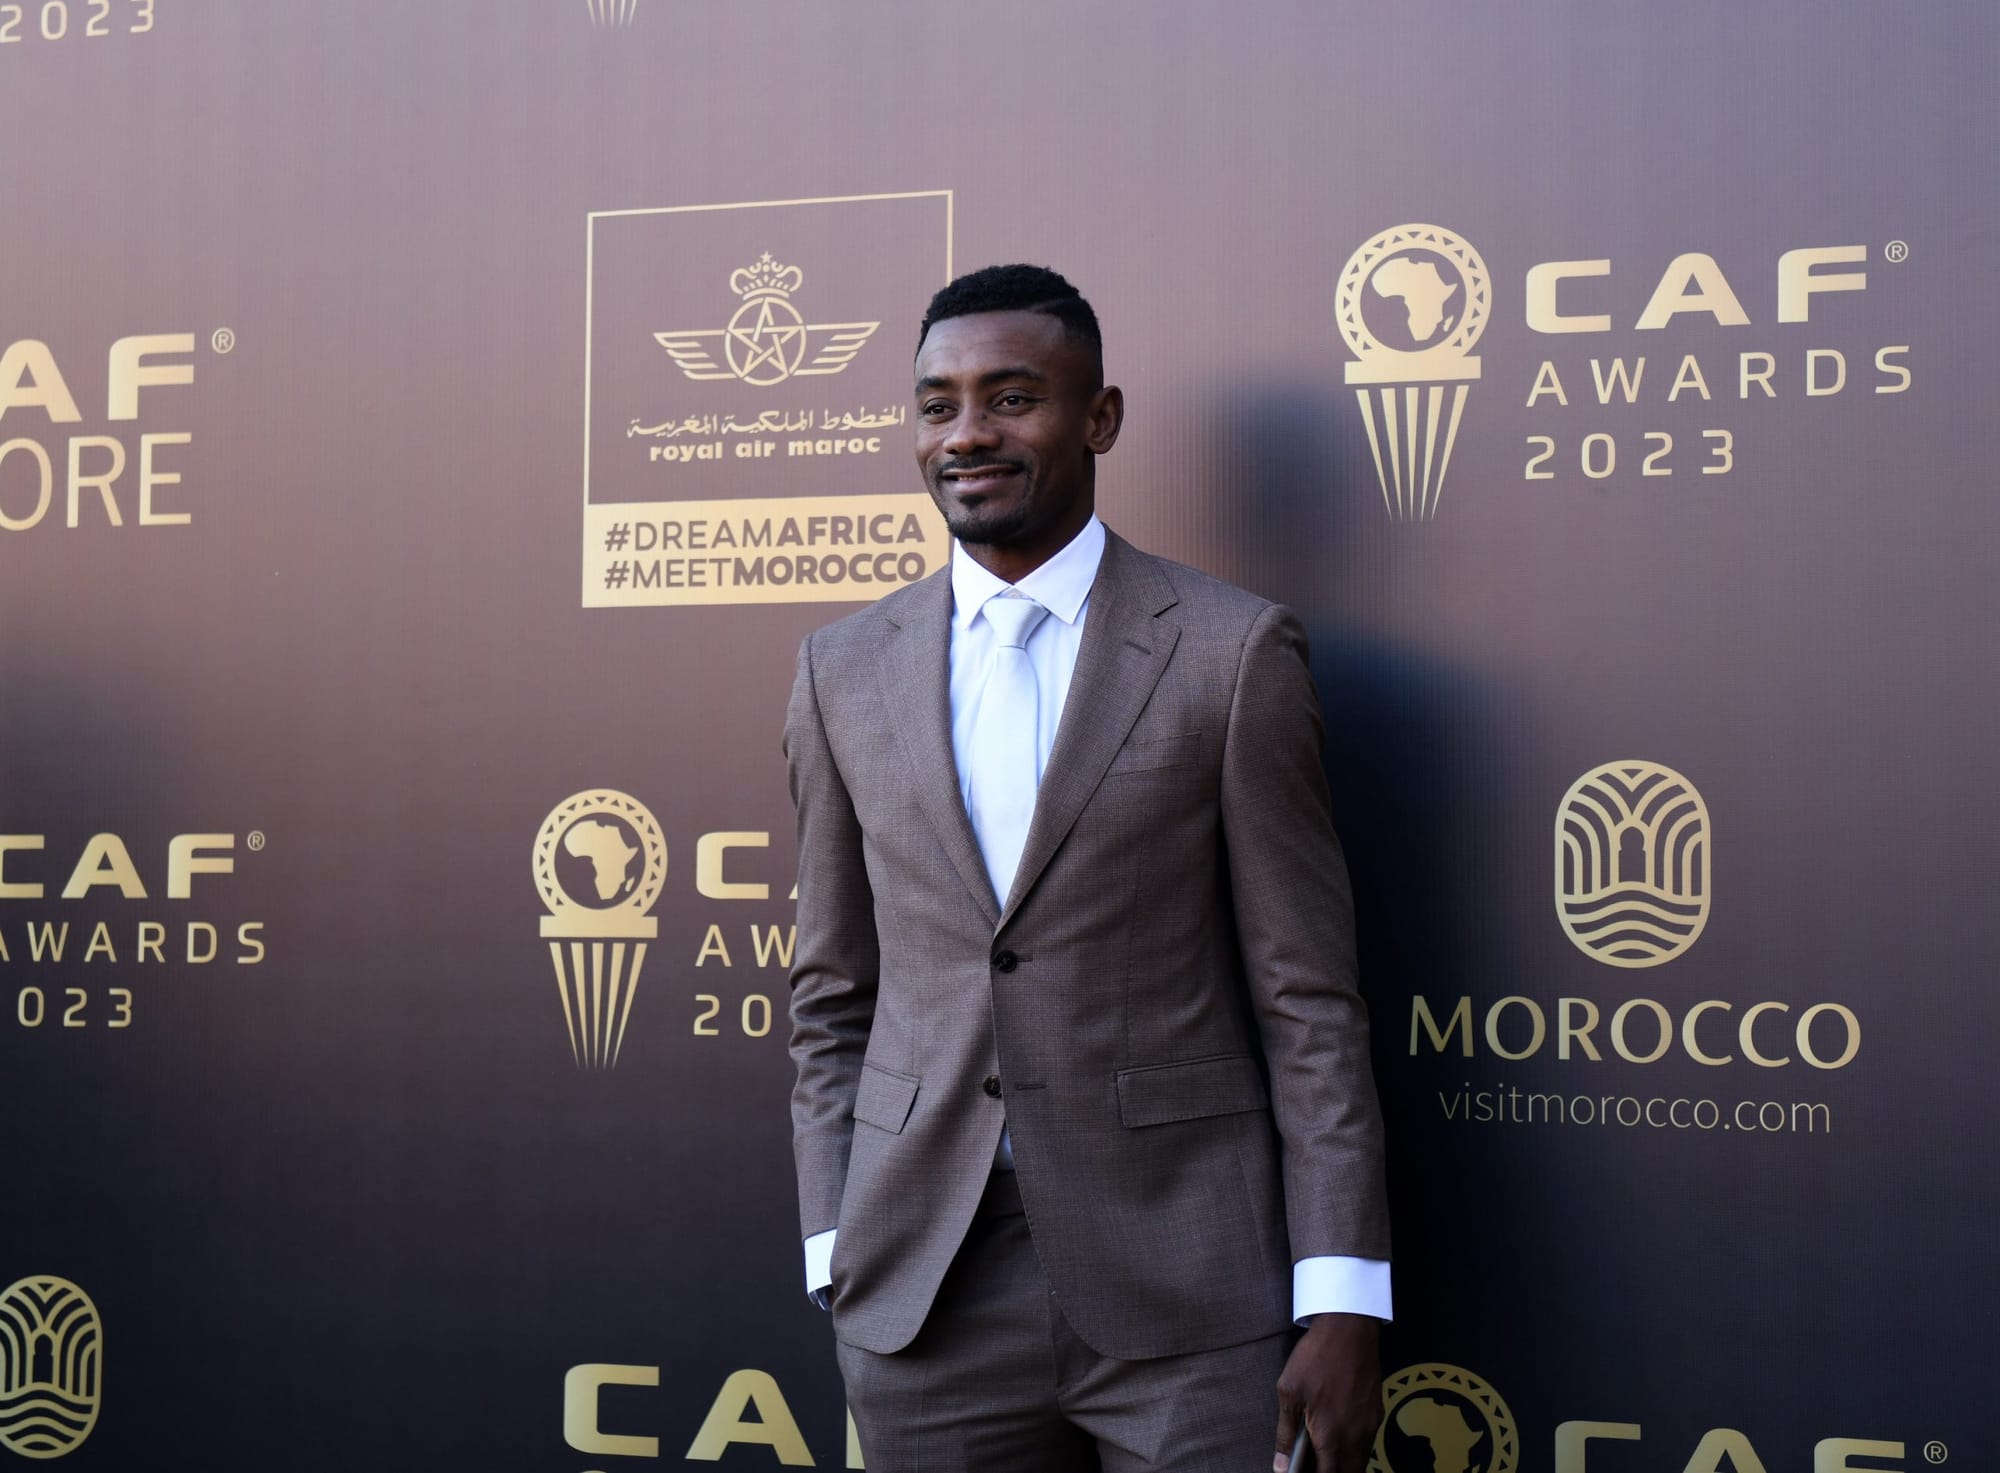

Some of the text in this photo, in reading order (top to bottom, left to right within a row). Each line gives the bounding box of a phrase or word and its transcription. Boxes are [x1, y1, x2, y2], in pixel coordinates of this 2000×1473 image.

[0, 0, 155, 43] 2023
[1525, 245, 1867, 334] CAF
[0, 332, 195, 423] AF
[1525, 345, 1912, 408] AWARDS
[627, 404, 906, 439] الخطوط الملكية المغربية
[650, 436, 881, 463] royal air maroc
[1525, 429, 1734, 480] 2023
[0, 432, 192, 531] ORE
[604, 513, 926, 552] #DREAMAFRICA
[604, 552, 926, 589] #MEETMOROCCO
[0, 832, 235, 899] CAF
[17, 986, 133, 1028] 023
[693, 994, 772, 1037] 20
[1409, 995, 1861, 1070] MOROCCO
[1439, 1082, 1830, 1134] visitmorocco.com
[564, 1363, 866, 1469] CA
